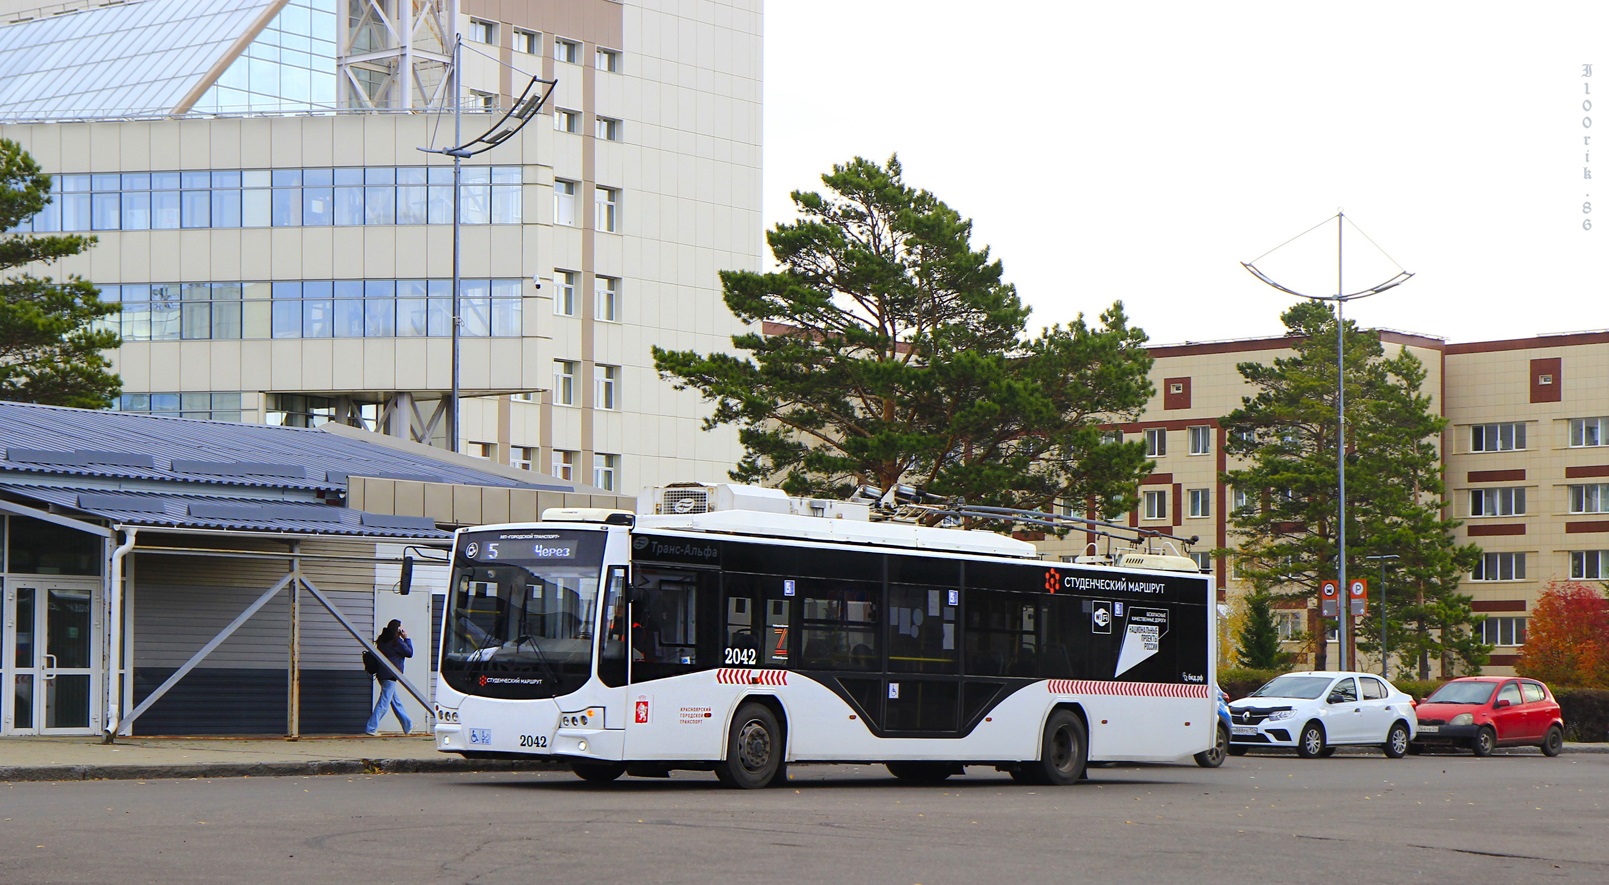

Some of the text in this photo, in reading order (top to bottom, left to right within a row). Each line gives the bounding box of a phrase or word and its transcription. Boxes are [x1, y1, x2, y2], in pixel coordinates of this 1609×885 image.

[488, 543, 499, 559] 5
[535, 544, 571, 557] Через
[651, 541, 718, 560] Транс-Альфа
[1064, 577, 1165, 594] СТУДЕНЧЕСКИЙ МАРШРУТ
[1355, 584, 1362, 593] P
[1129, 625, 1158, 634] НАЦИОНАЛЬНЫЕ
[1141, 634, 1158, 643] ПРОЕКТЫ
[1144, 642, 1158, 651] РОССИИ
[725, 648, 756, 665] 2042
[487, 676, 520, 684] СТУДЕНЧЕСКИЙ
[520, 735, 547, 748] 2042
